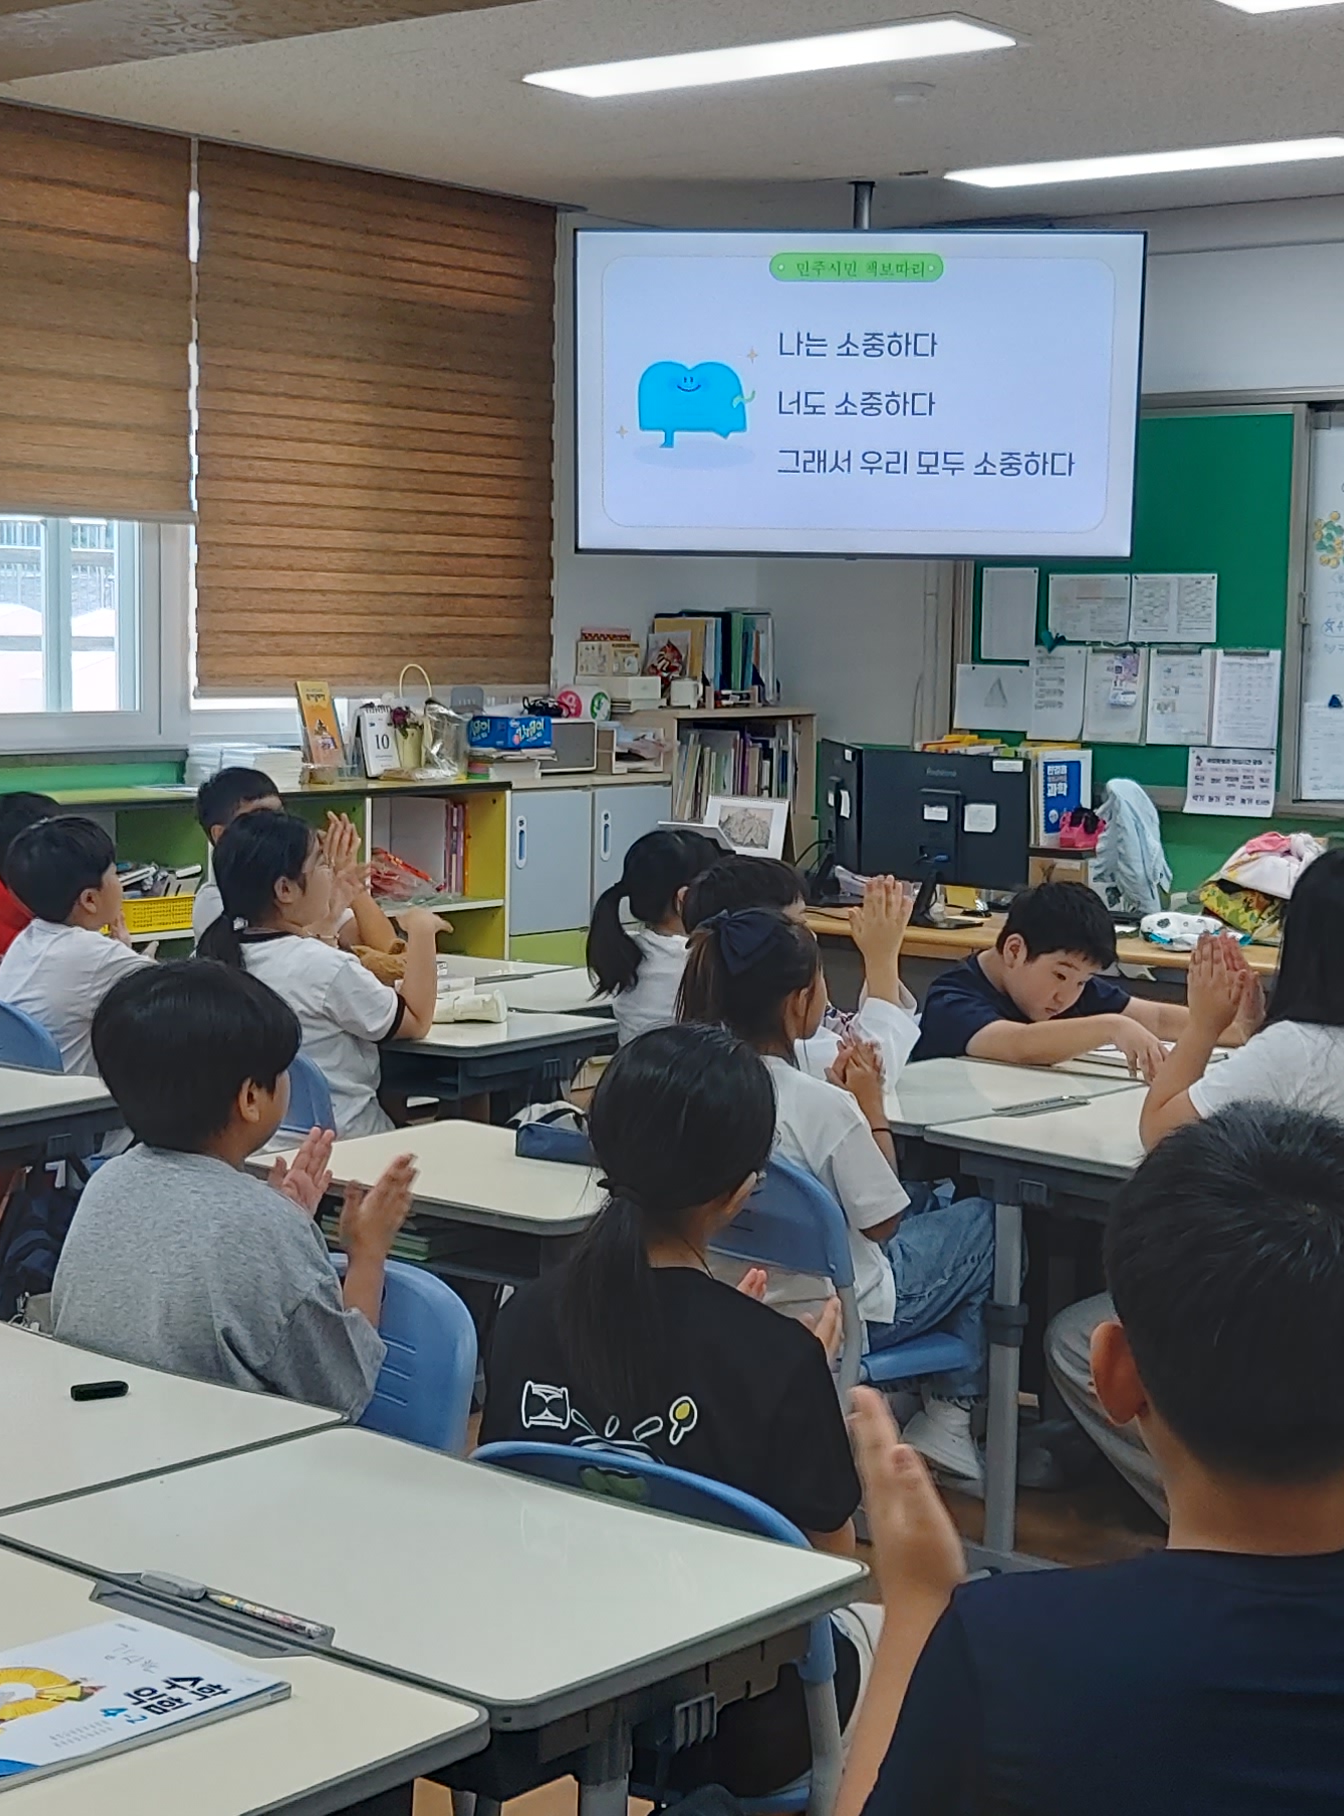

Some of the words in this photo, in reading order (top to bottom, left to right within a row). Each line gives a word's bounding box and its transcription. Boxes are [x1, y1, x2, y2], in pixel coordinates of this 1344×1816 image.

[796, 260, 857, 277] 민주시민
[777, 331, 828, 358] 나는
[836, 330, 938, 358] 소중하다
[777, 390, 826, 416] 너도
[834, 389, 935, 418] 소중하다
[777, 449, 852, 475] 그래서
[859, 450, 908, 477] 우리
[916, 451, 966, 477] 모두
[973, 450, 1076, 478] 소중하다
[375, 733, 390, 750] 10
[123, 1687, 193, 1715] 익힘
[161, 1676, 232, 1701] 수학
